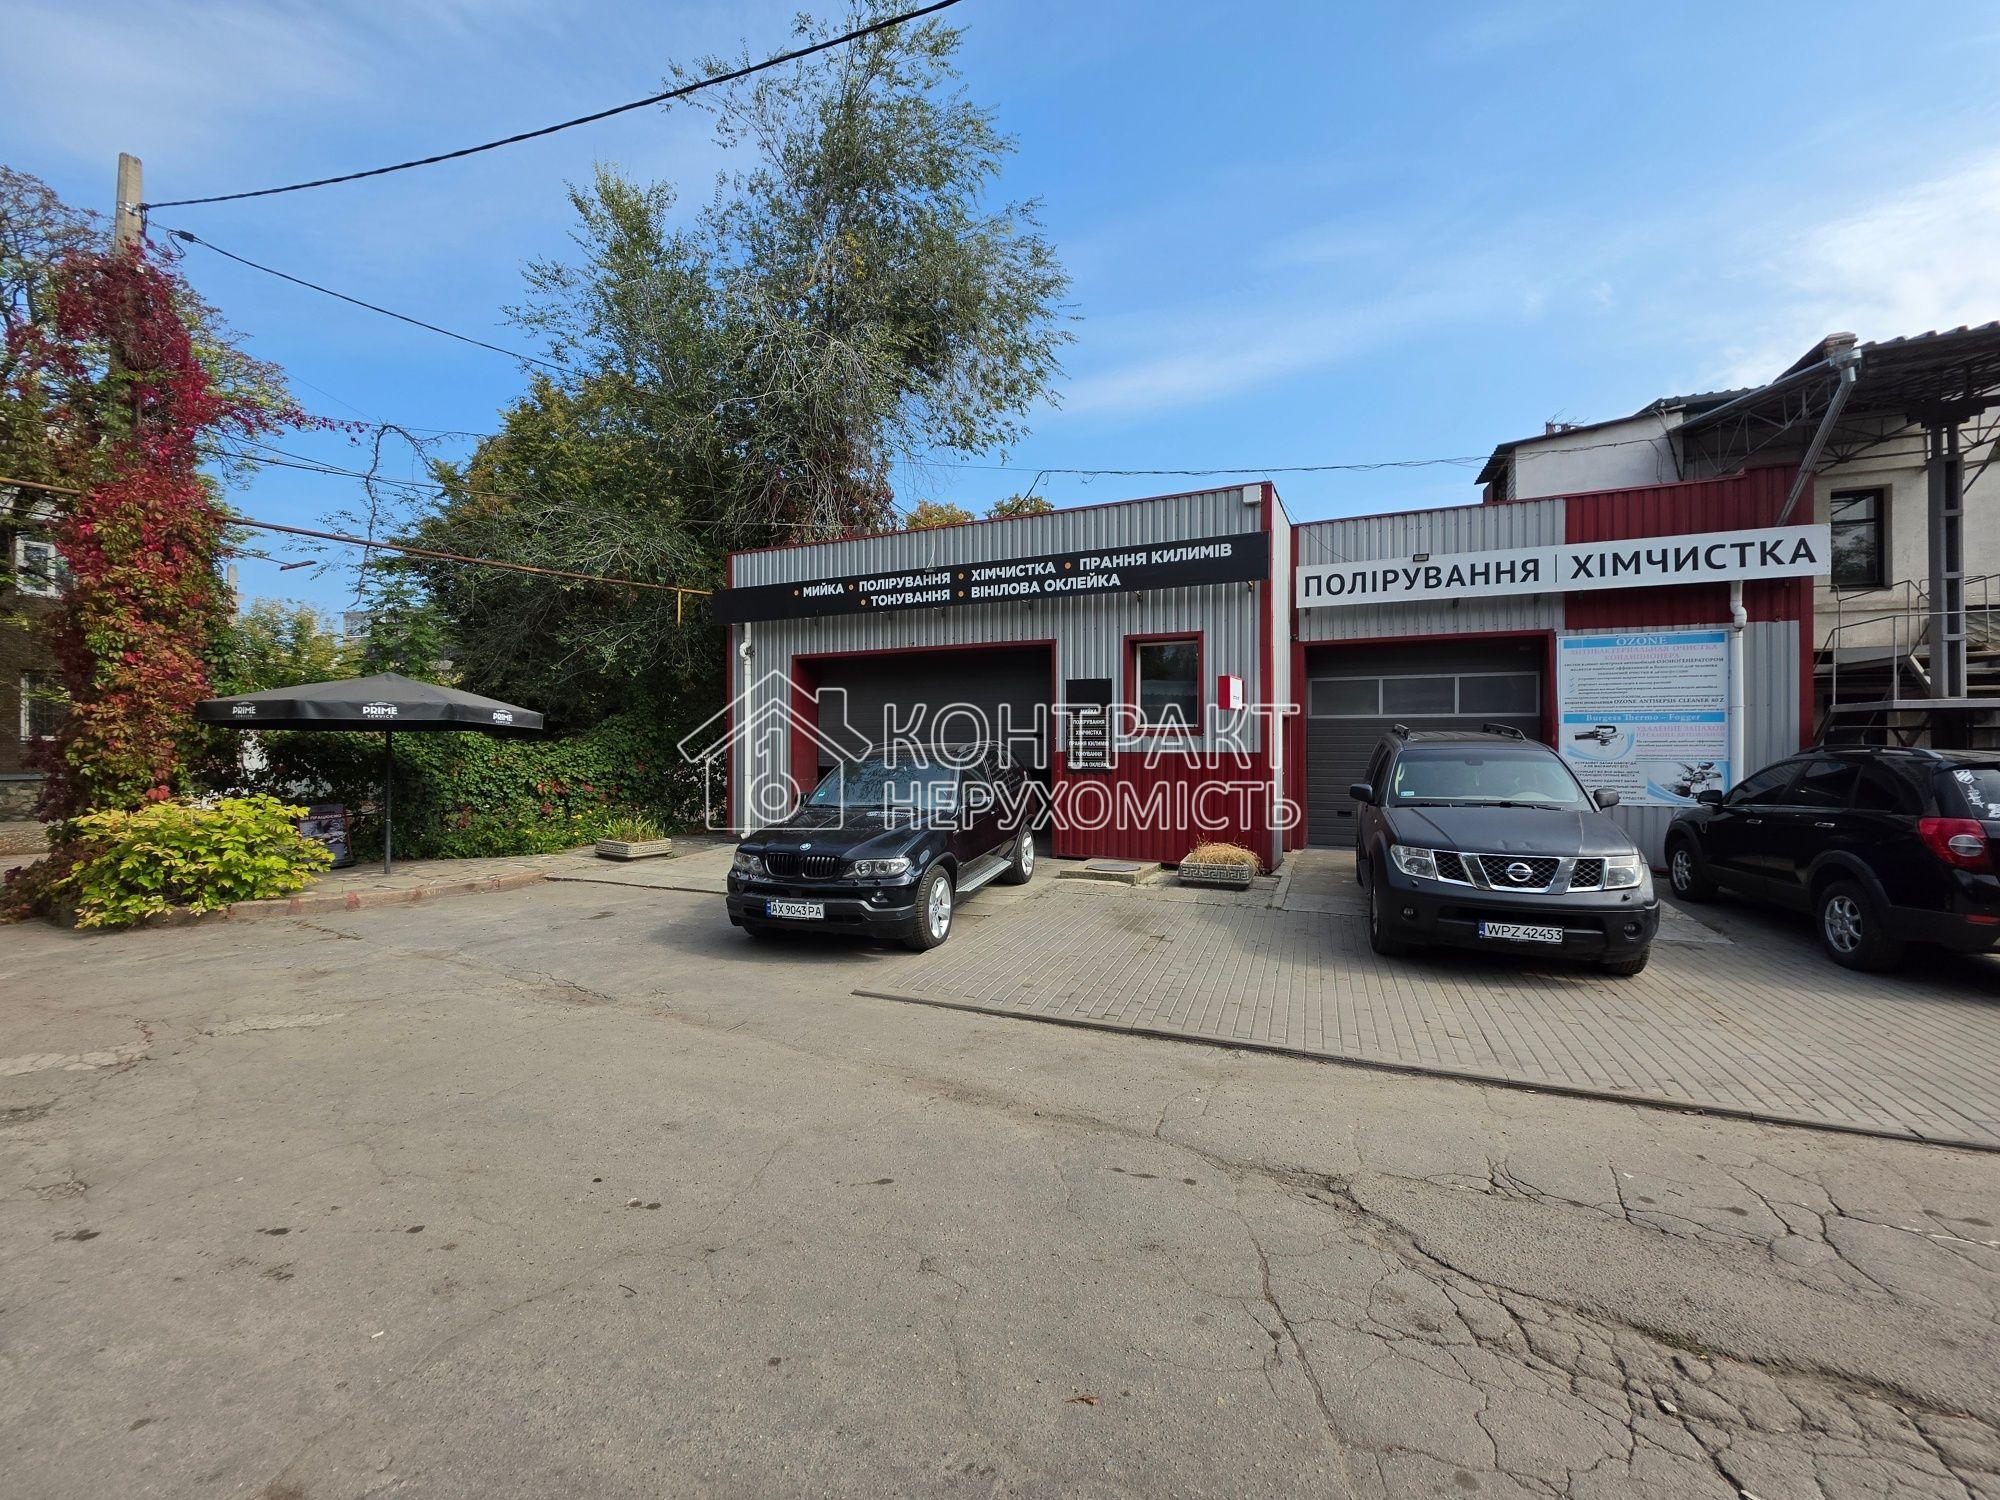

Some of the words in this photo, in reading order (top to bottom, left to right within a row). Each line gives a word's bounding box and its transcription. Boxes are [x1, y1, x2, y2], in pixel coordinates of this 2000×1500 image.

[803, 582, 844, 597] МИЙКА
[859, 572, 951, 592] ПОЛІРУВАННЯ
[971, 561, 1056, 581] ХІМЧИСТКА
[1080, 552, 1147, 571] ПРАННЯ
[1151, 543, 1233, 564] КИЛИМІВ
[1304, 557, 1540, 598] ПОЛІРУВАННЯ
[1570, 537, 1818, 580] ХІМЧИСТКА
[871, 589, 951, 607] ТОНУВАННЯ
[971, 580, 1040, 599] ВІНІЛОВА
[1044, 573, 1121, 591] ОКЛЕЙКА
[1616, 635, 1668, 646] OZONE
[232, 706, 256, 714] PRIME
[362, 706, 398, 715] PRIME
[492, 712, 513, 722] PRIME
[772, 904, 784, 914] AX
[785, 905, 806, 915] 9043
[808, 907, 821, 916] PA
[1487, 924, 1520, 937] WPZ
[1523, 928, 1562, 940] 42453
